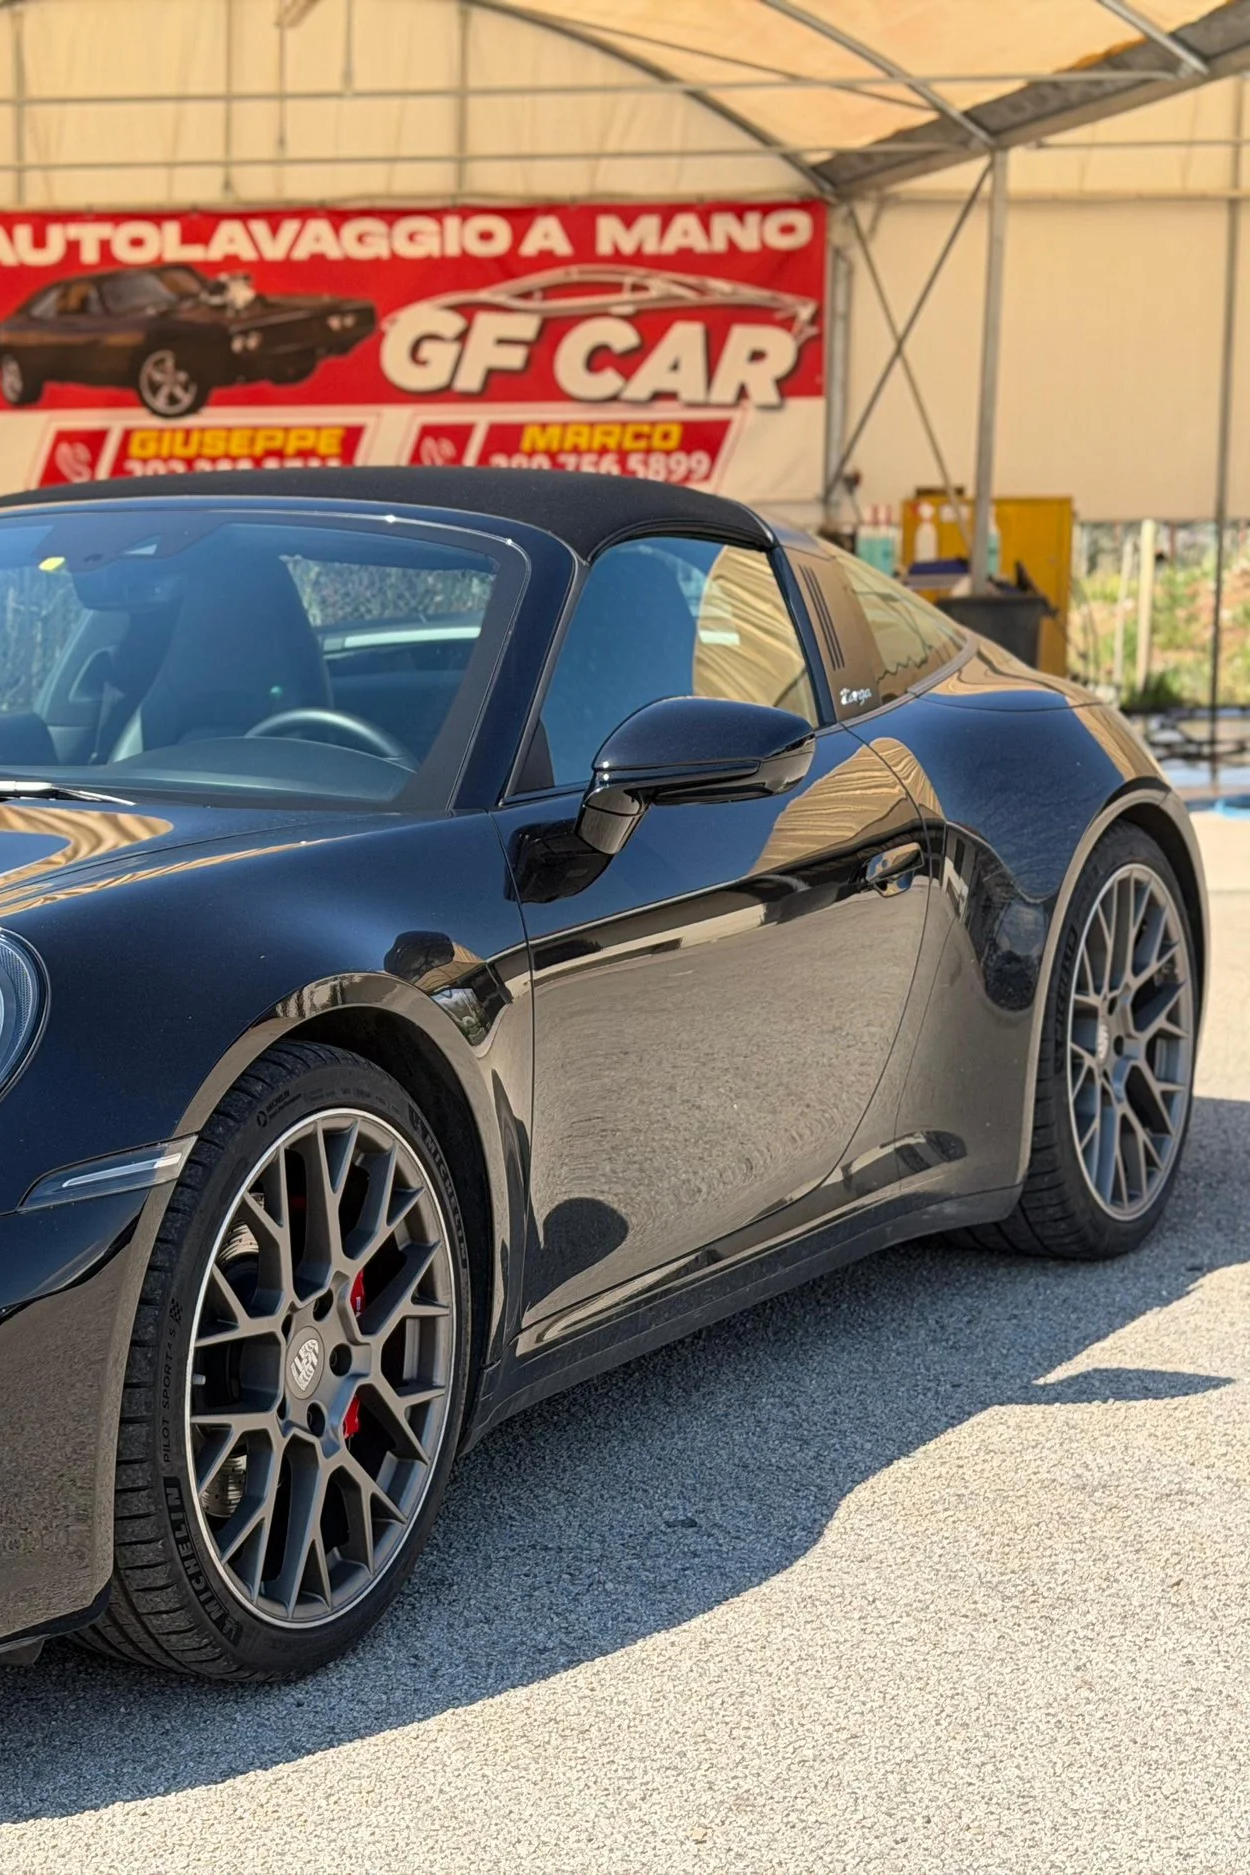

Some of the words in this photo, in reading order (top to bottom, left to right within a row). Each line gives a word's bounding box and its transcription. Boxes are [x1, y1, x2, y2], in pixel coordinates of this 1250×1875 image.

[518, 214, 574, 258] A
[595, 209, 815, 257] MANO
[379, 307, 542, 394] GF
[552, 316, 798, 407] CAR
[128, 427, 345, 460] GIUSEPPE
[520, 422, 683, 453] MARCO
[626, 450, 711, 482] 5899
[162, 1353, 174, 1411] SPORT
[162, 1416, 171, 1463] PILOT
[164, 1486, 226, 1621] MICHELIN
